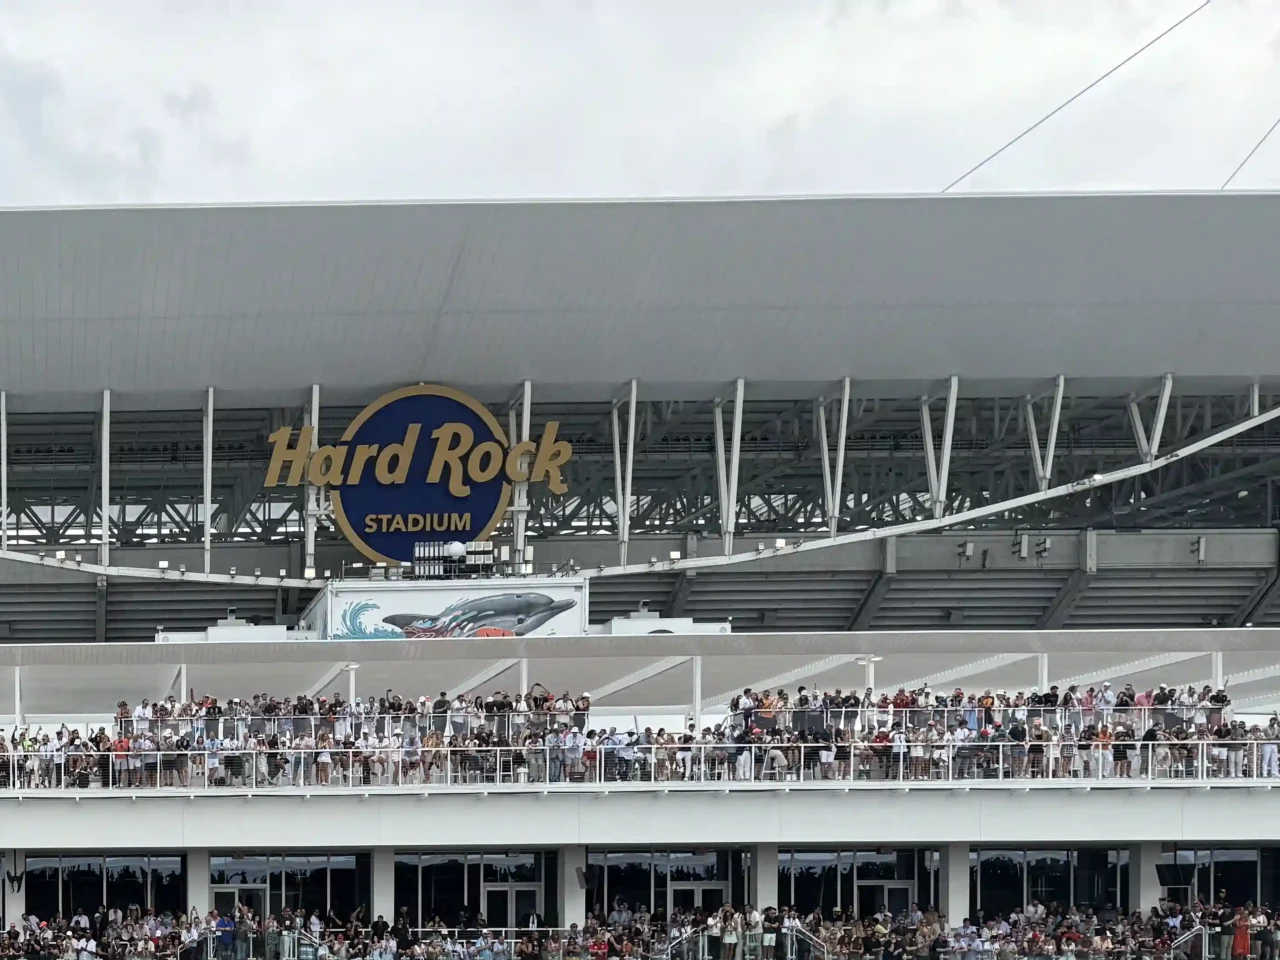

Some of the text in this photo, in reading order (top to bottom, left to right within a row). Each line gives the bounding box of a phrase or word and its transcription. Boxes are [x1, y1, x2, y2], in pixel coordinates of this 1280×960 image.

[263, 421, 573, 498] Hard Rock
[364, 512, 472, 534] STADIUM
